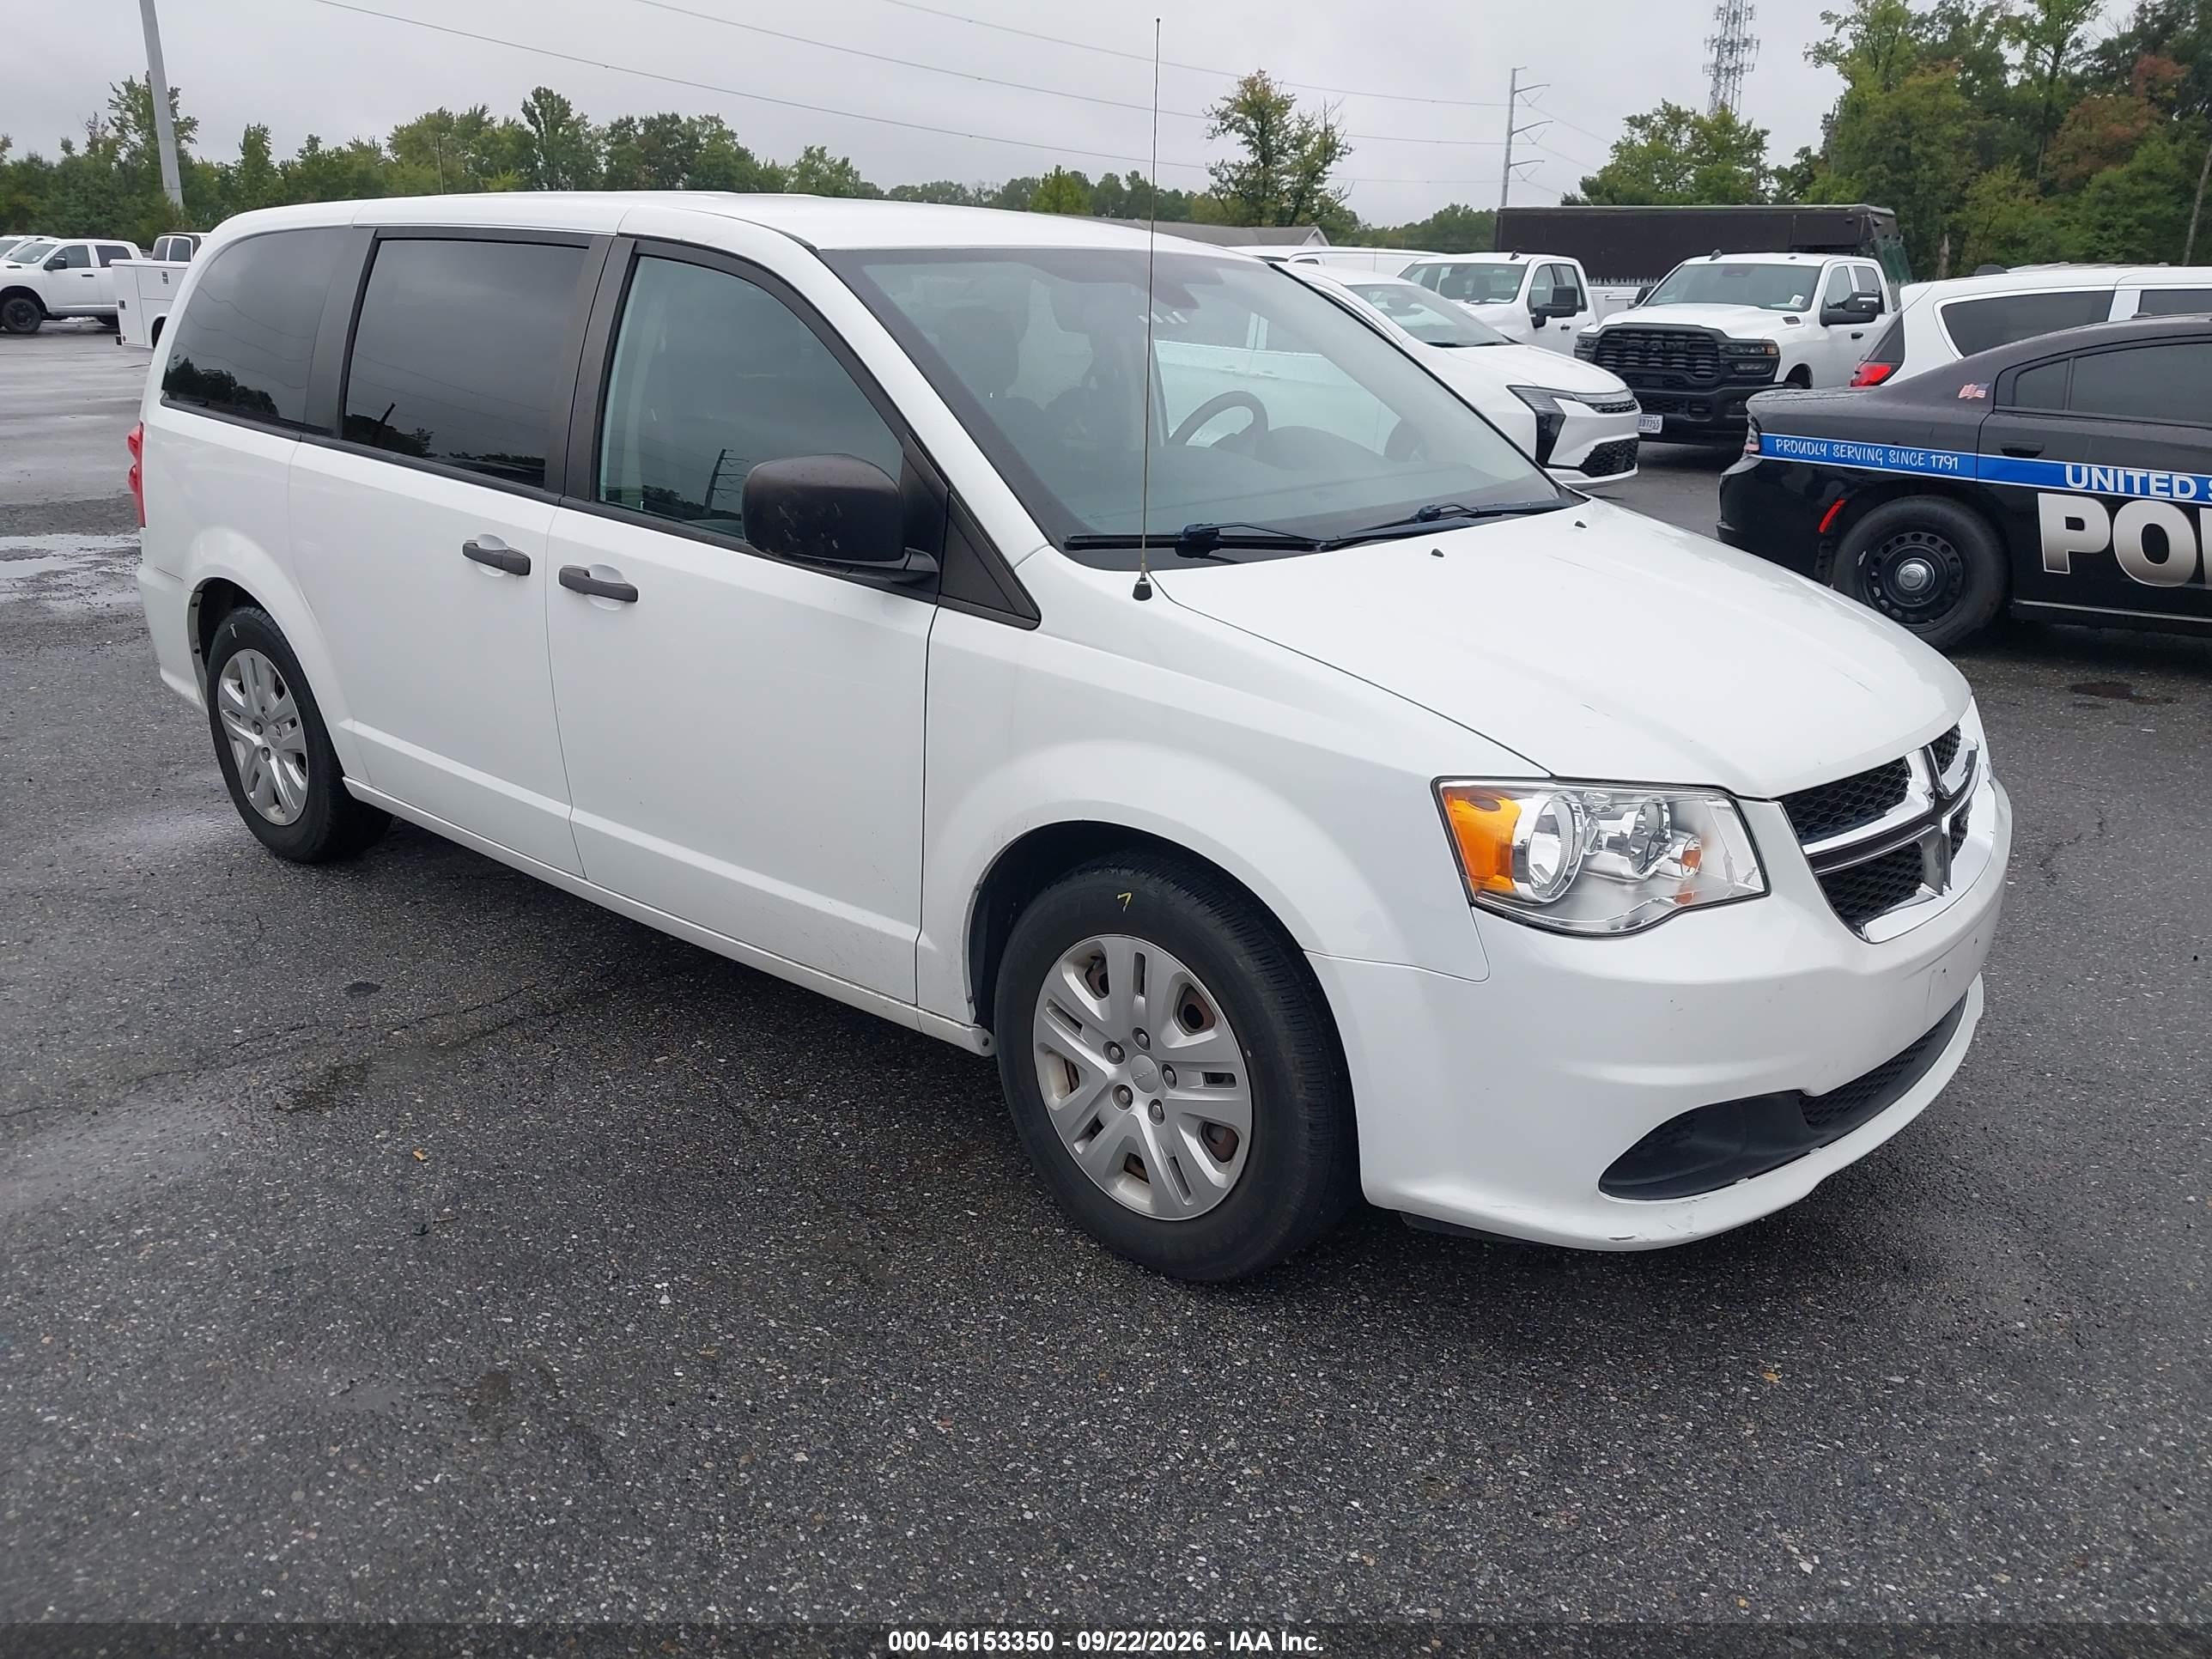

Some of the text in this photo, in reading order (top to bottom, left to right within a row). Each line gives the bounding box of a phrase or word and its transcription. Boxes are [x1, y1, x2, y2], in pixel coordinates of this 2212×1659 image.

[1775, 439, 1959, 470] PROUDLY SERVING SINCE 1791
[2065, 465, 2197, 499] UNITED
